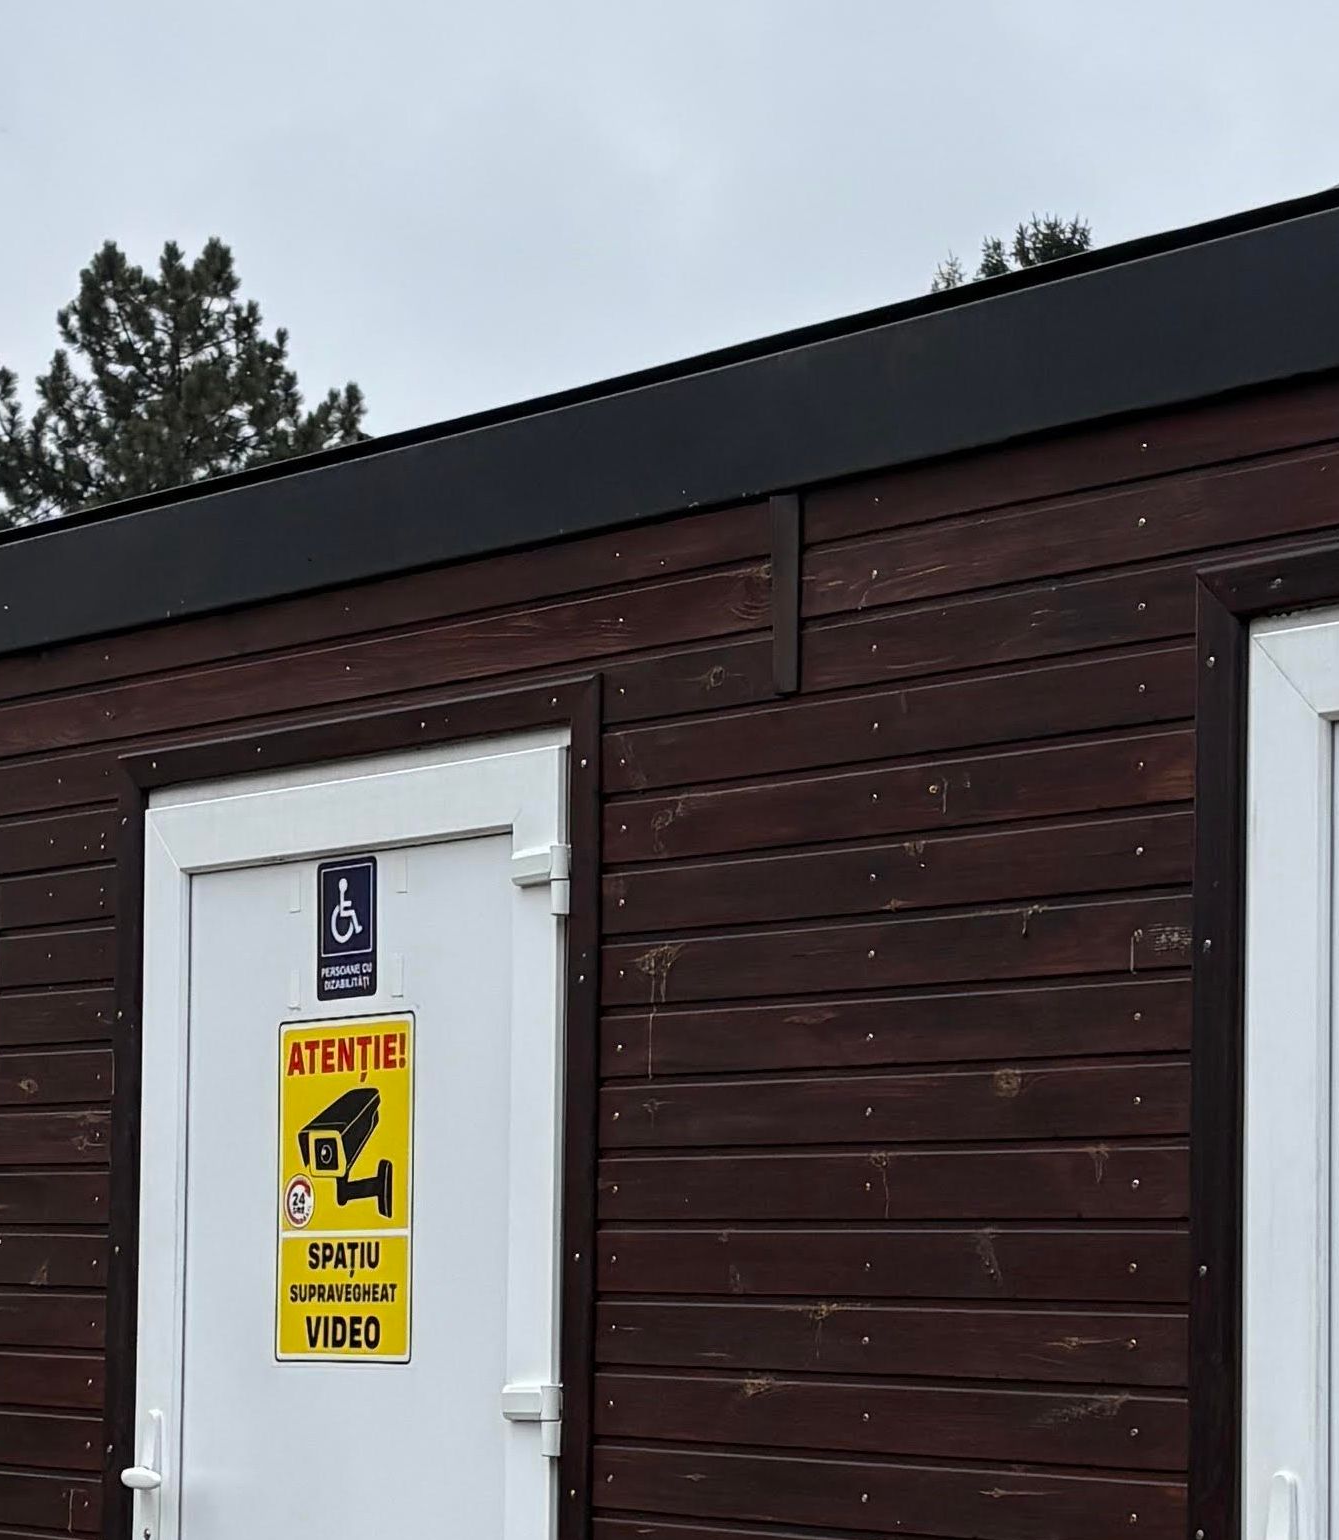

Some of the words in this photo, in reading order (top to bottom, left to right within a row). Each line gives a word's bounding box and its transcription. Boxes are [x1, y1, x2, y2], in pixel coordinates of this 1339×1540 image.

[321, 963, 361, 978] PERSOANE
[362, 962, 373, 974] CU
[292, 1192, 306, 1206] 24
[290, 1283, 398, 1304] SUPRAVEGHEAT
[306, 1315, 381, 1349] VIDEO
